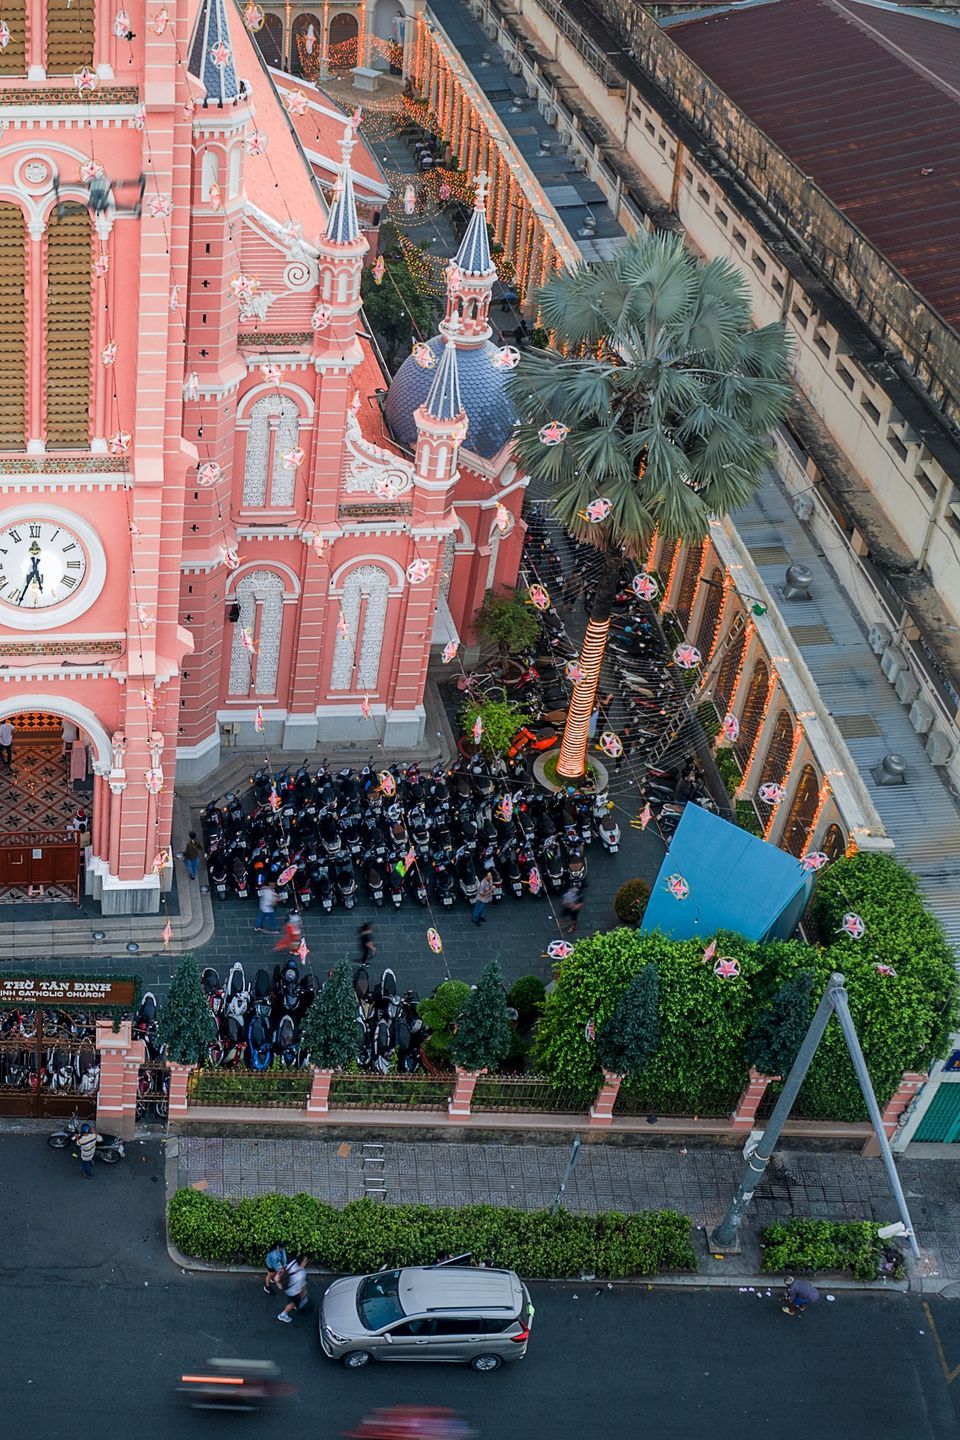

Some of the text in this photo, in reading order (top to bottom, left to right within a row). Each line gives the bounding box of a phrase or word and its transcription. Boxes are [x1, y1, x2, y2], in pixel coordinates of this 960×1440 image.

[9, 530, 22, 543] XI
[29, 525, 41, 538] XII
[50, 530, 59, 542] I
[62, 543, 76, 553] II
[66, 560, 81, 569] III
[4, 980, 35, 990] THỜ
[40, 982, 70, 990] TÂN
[74, 983, 112, 992] ĐỊNH
